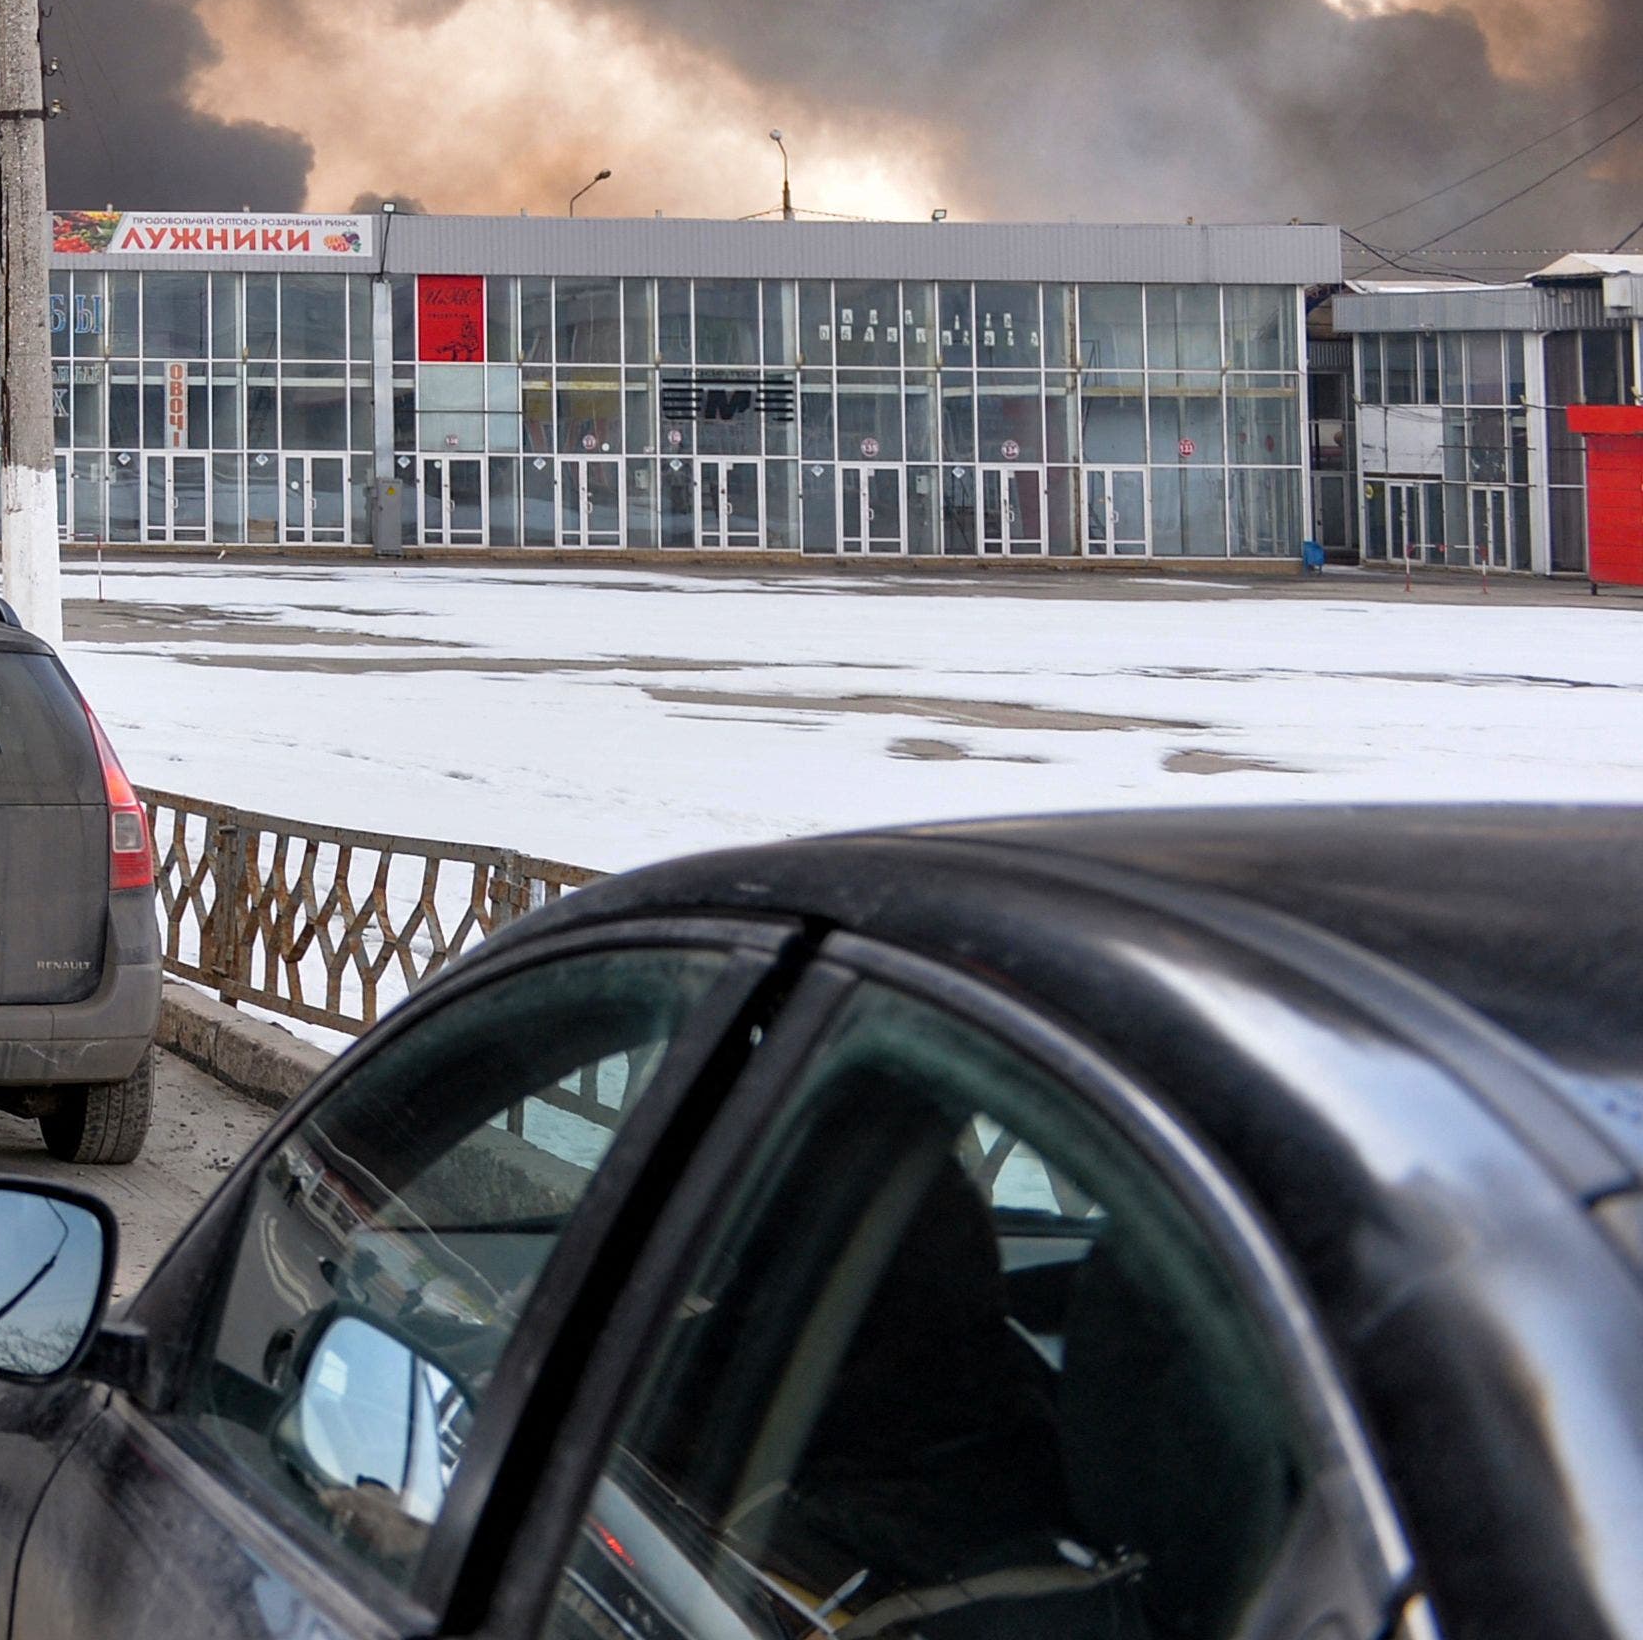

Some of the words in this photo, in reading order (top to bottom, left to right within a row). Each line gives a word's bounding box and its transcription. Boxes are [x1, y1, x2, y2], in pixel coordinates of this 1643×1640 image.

[120, 227, 311, 252] ЛУЖНИКИ
[169, 363, 184, 448] ОВОЧІ
[36, 960, 92, 971] RENAULT
